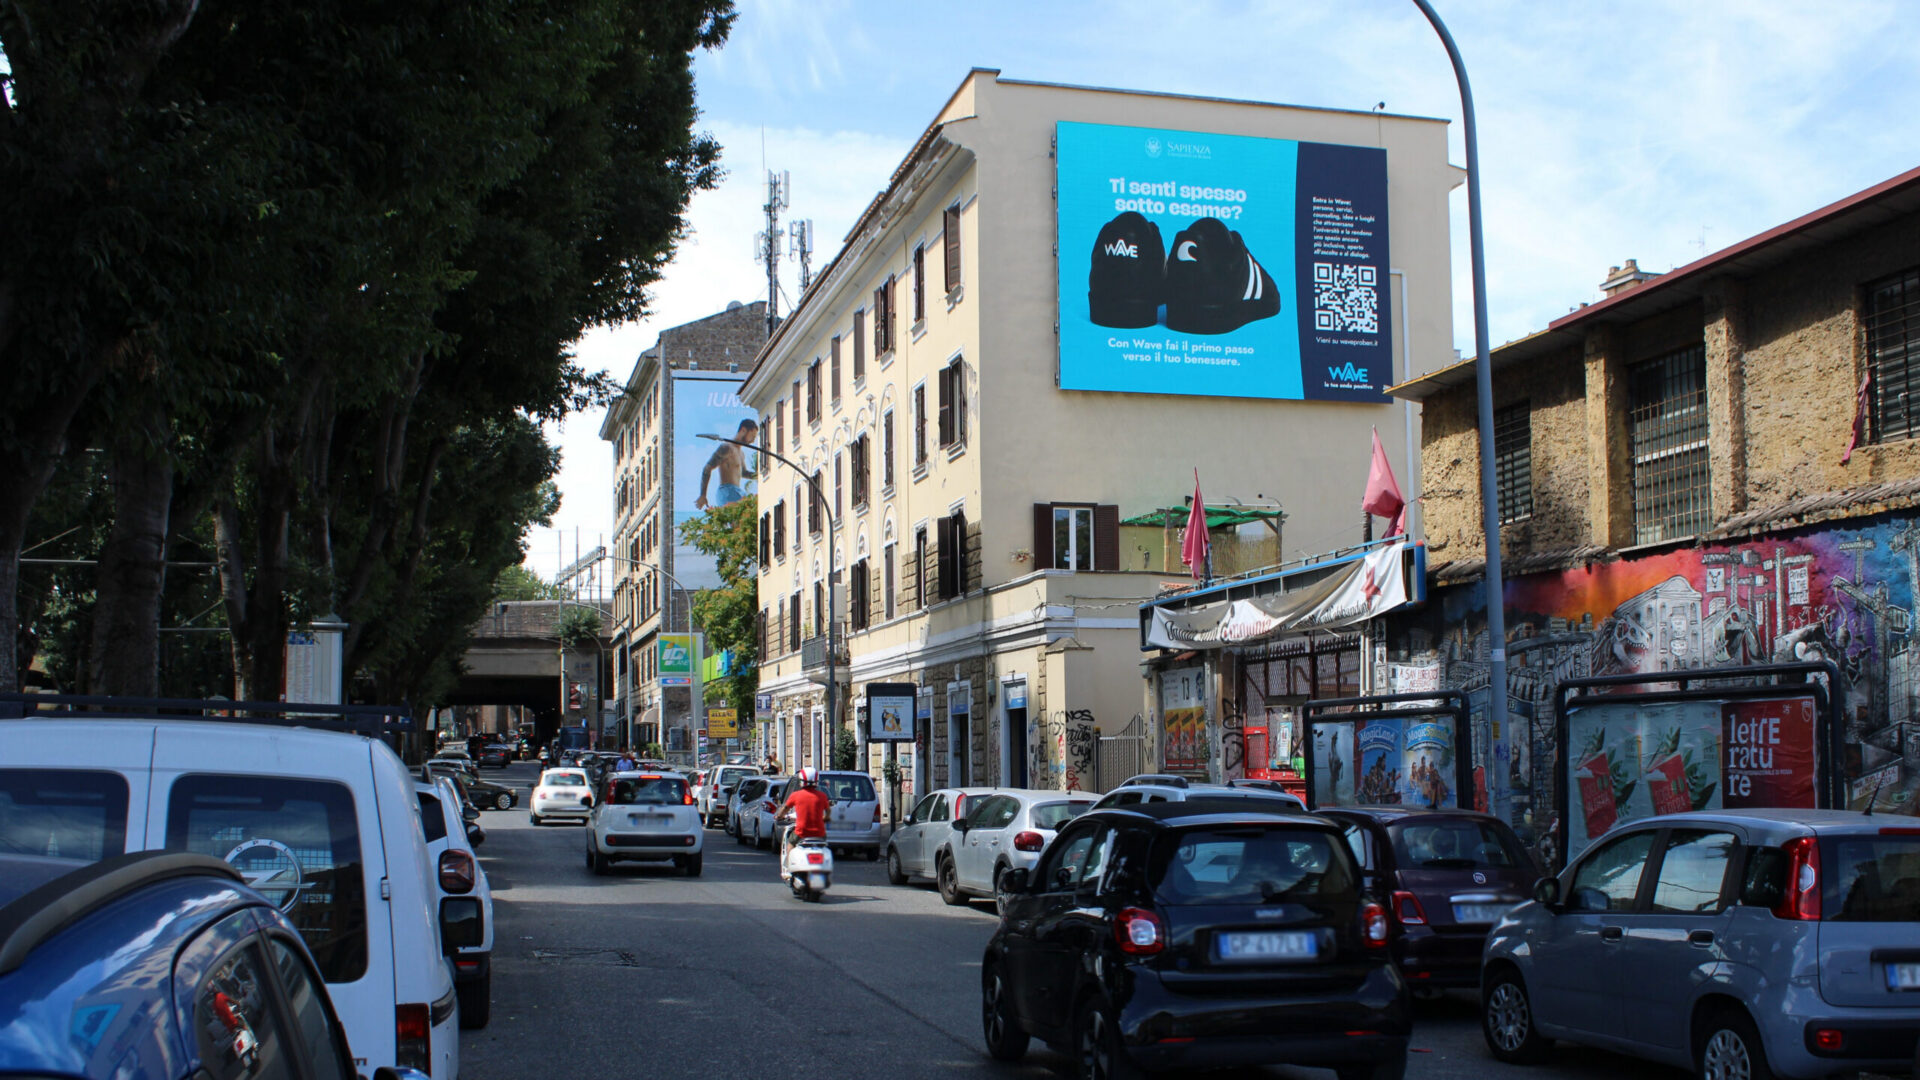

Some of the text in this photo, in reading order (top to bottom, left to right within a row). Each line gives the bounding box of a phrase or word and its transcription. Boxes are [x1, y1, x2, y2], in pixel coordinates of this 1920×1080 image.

[1109, 177, 1247, 202] Ti senti spesso
[1114, 197, 1242, 219] sotto esame?
[1360, 215, 1375, 224] luoghi
[1104, 238, 1138, 258] WAVE
[1107, 337, 1255, 356] Con Wave fai il primo passo
[1122, 351, 1241, 367] verso il tuo benessere.
[1328, 362, 1368, 383] WAVE
[1728, 744, 1773, 768] ratu
[1728, 773, 1751, 797] re
[236, 840, 289, 854] OPEL
